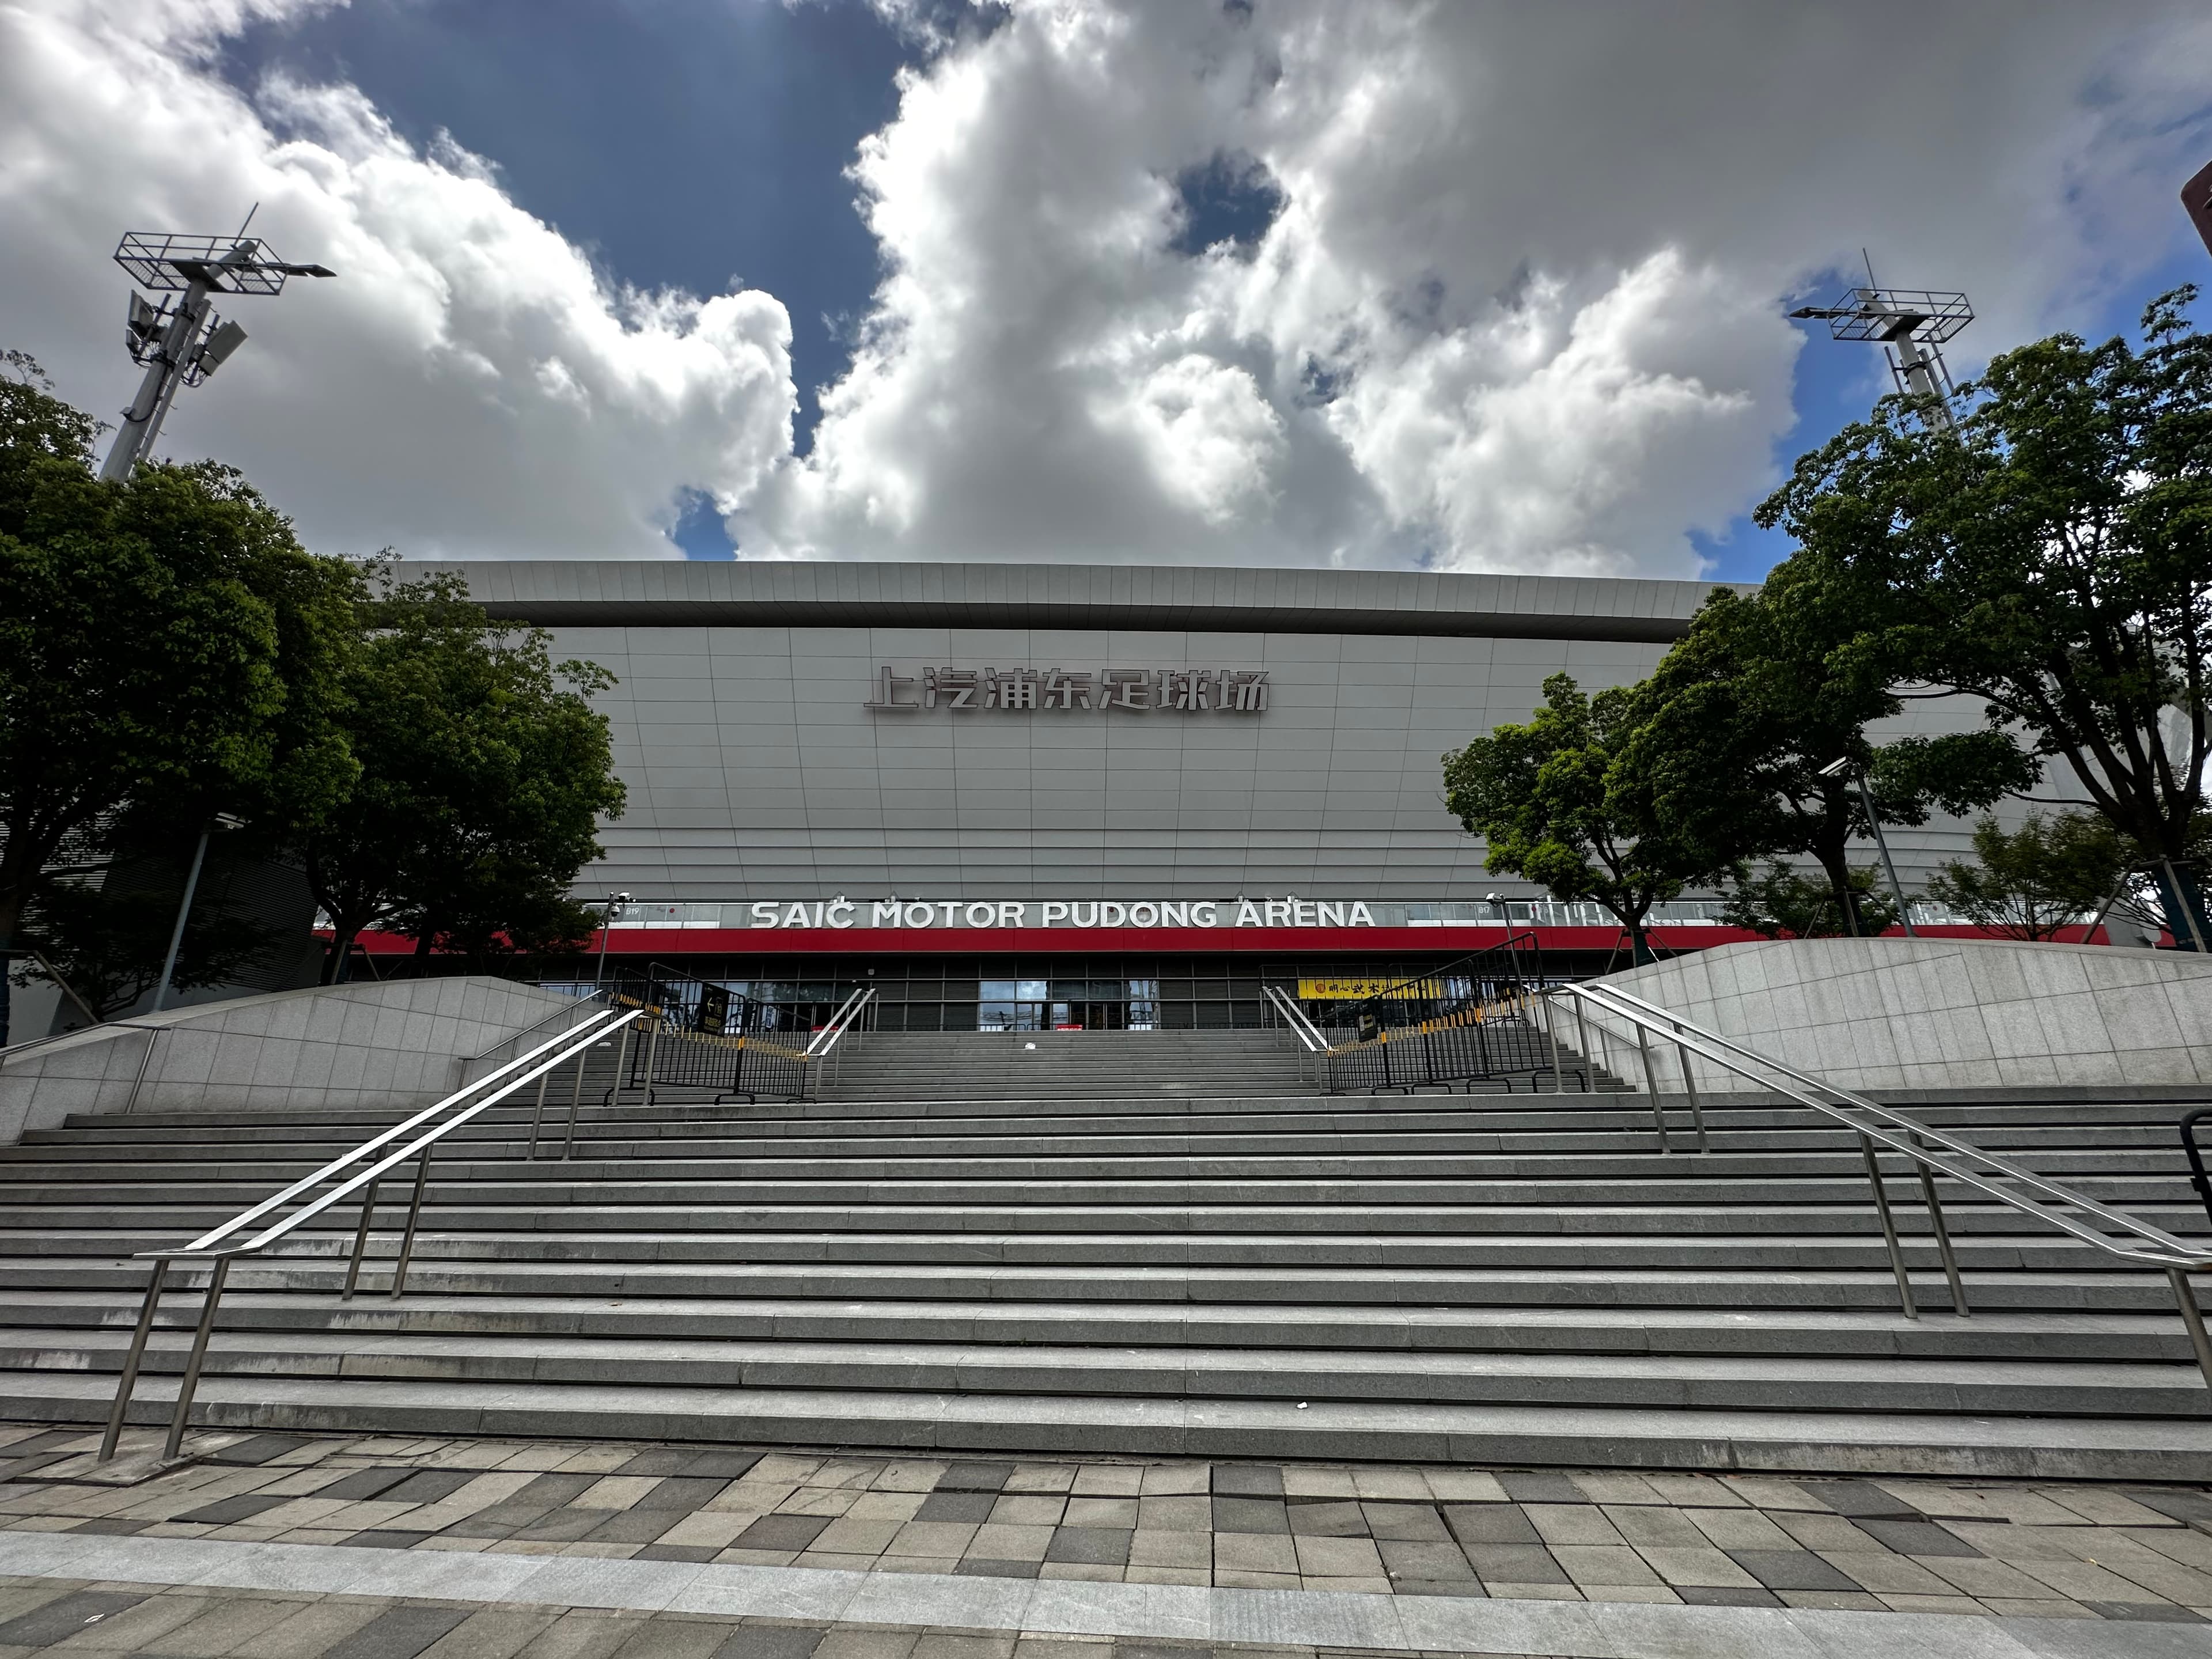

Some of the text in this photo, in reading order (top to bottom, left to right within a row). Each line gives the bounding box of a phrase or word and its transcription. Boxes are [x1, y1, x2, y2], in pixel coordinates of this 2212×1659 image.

[864, 666, 1269, 711] 上汽浦东足球场
[626, 907, 639, 915] B19
[751, 900, 1376, 929] SAIC MOTOR PUDONG ARENA
[1478, 906, 1490, 914] B17
